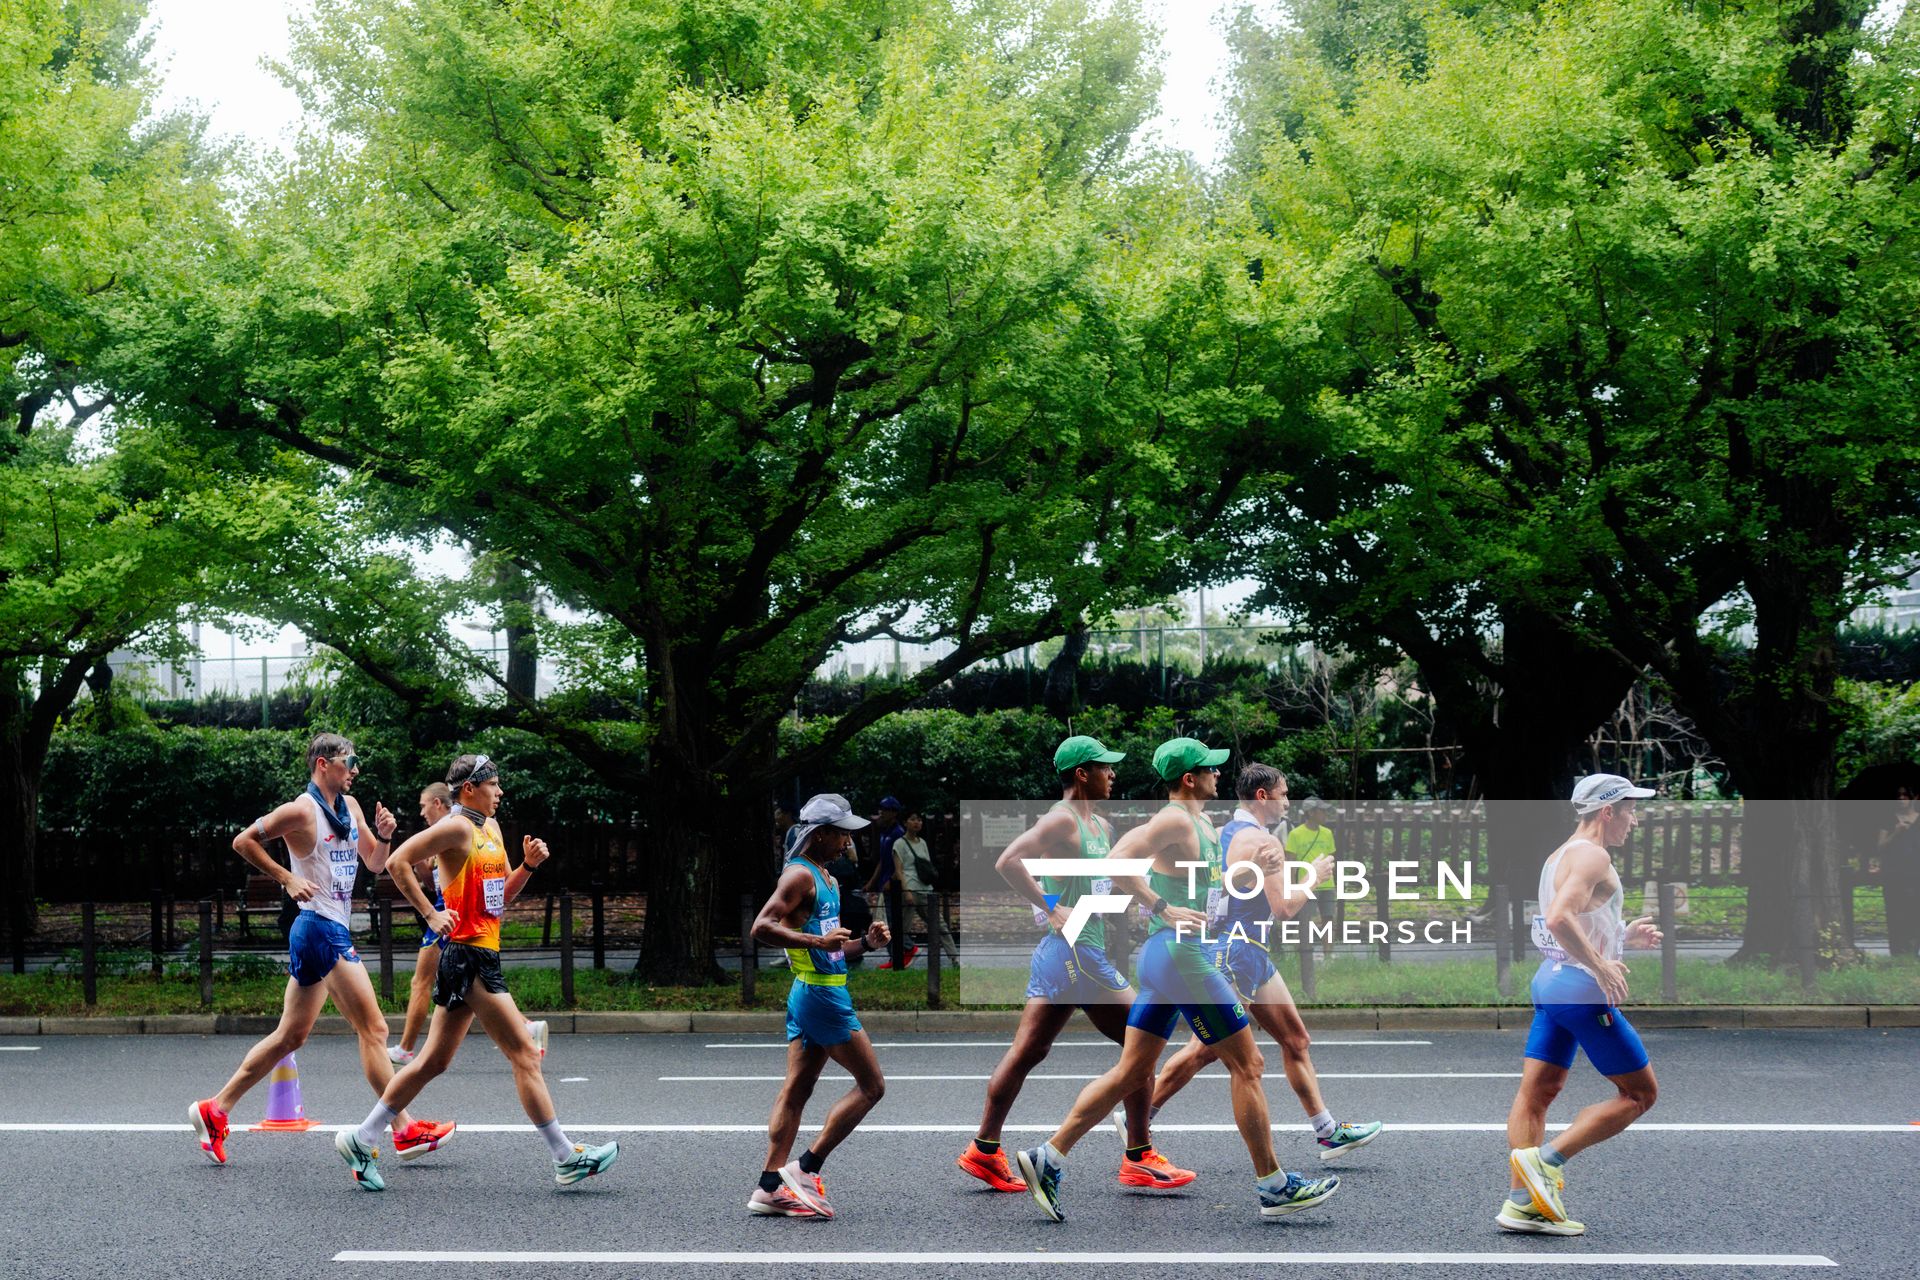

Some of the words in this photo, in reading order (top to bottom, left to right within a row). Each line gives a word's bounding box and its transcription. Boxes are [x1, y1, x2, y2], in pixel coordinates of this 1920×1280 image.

[1600, 788, 1619, 800] ITALIA
[1064, 960, 1079, 984] BRASIL
[1192, 1016, 1211, 1039] BRASIL
